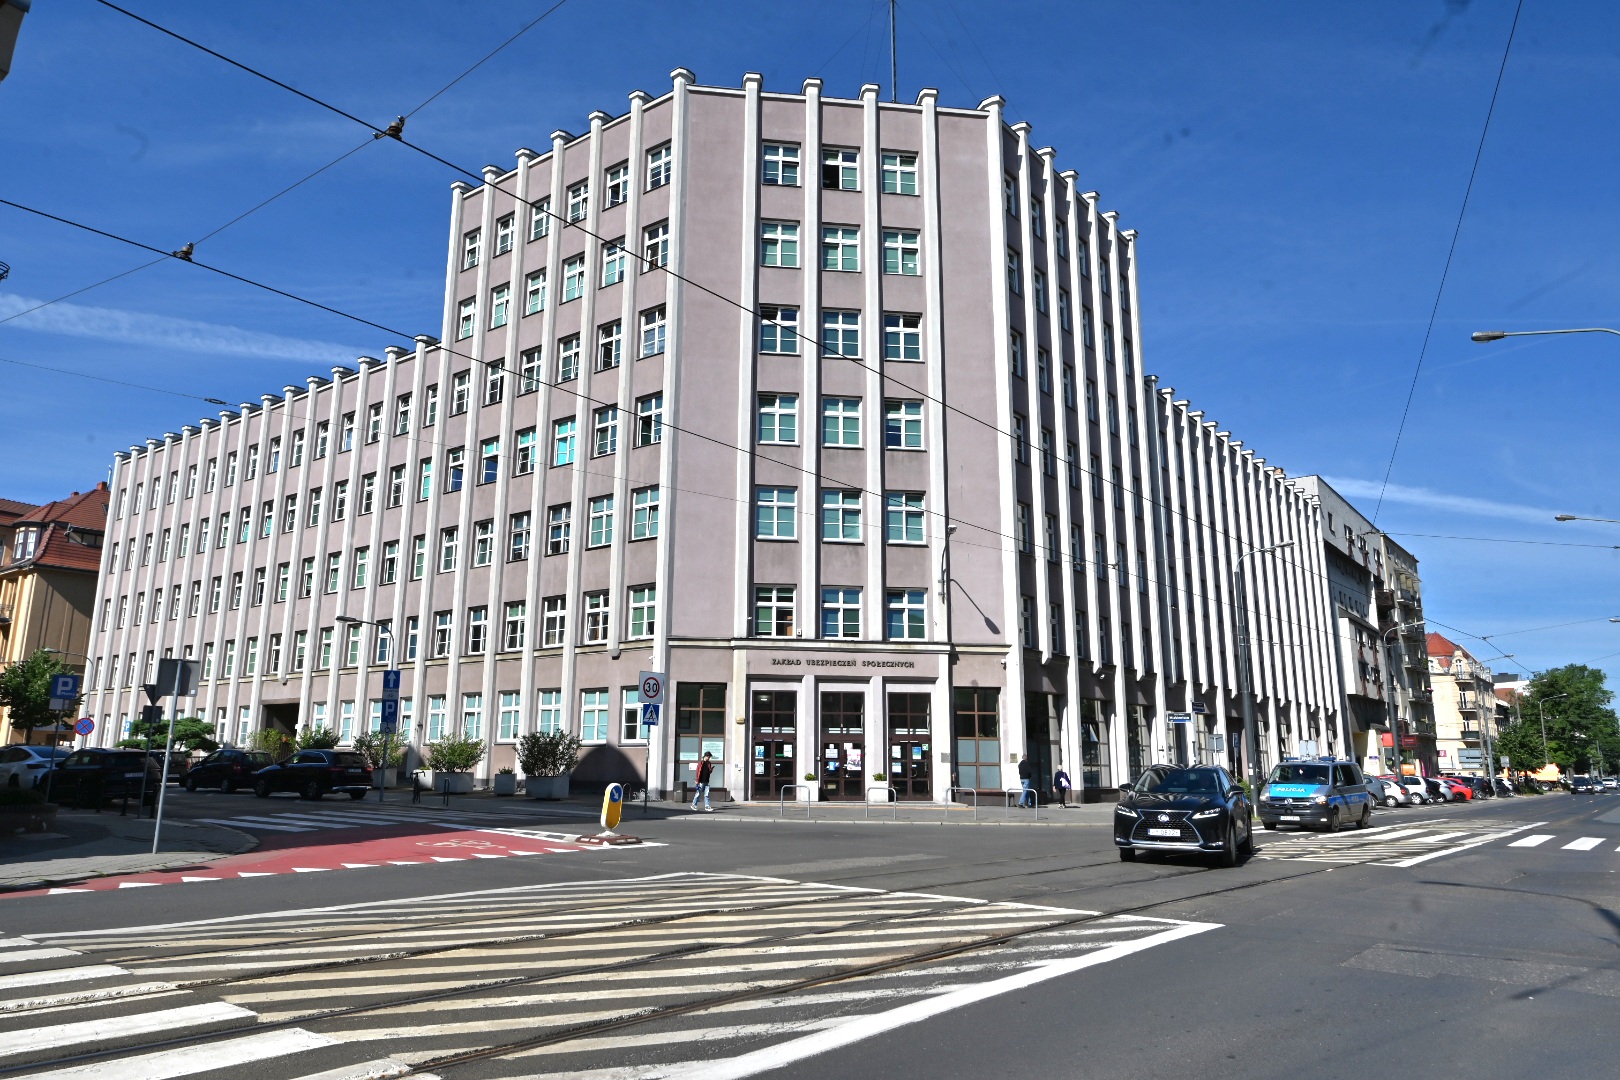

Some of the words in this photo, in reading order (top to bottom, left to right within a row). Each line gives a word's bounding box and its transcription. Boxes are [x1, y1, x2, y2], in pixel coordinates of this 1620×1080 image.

[806, 658, 856, 667] UBEZPIECZEŃ
[862, 660, 914, 668] SPOŁECZNYCH
[57, 677, 73, 695] P
[645, 682, 657, 692] 30
[385, 702, 395, 716] P
